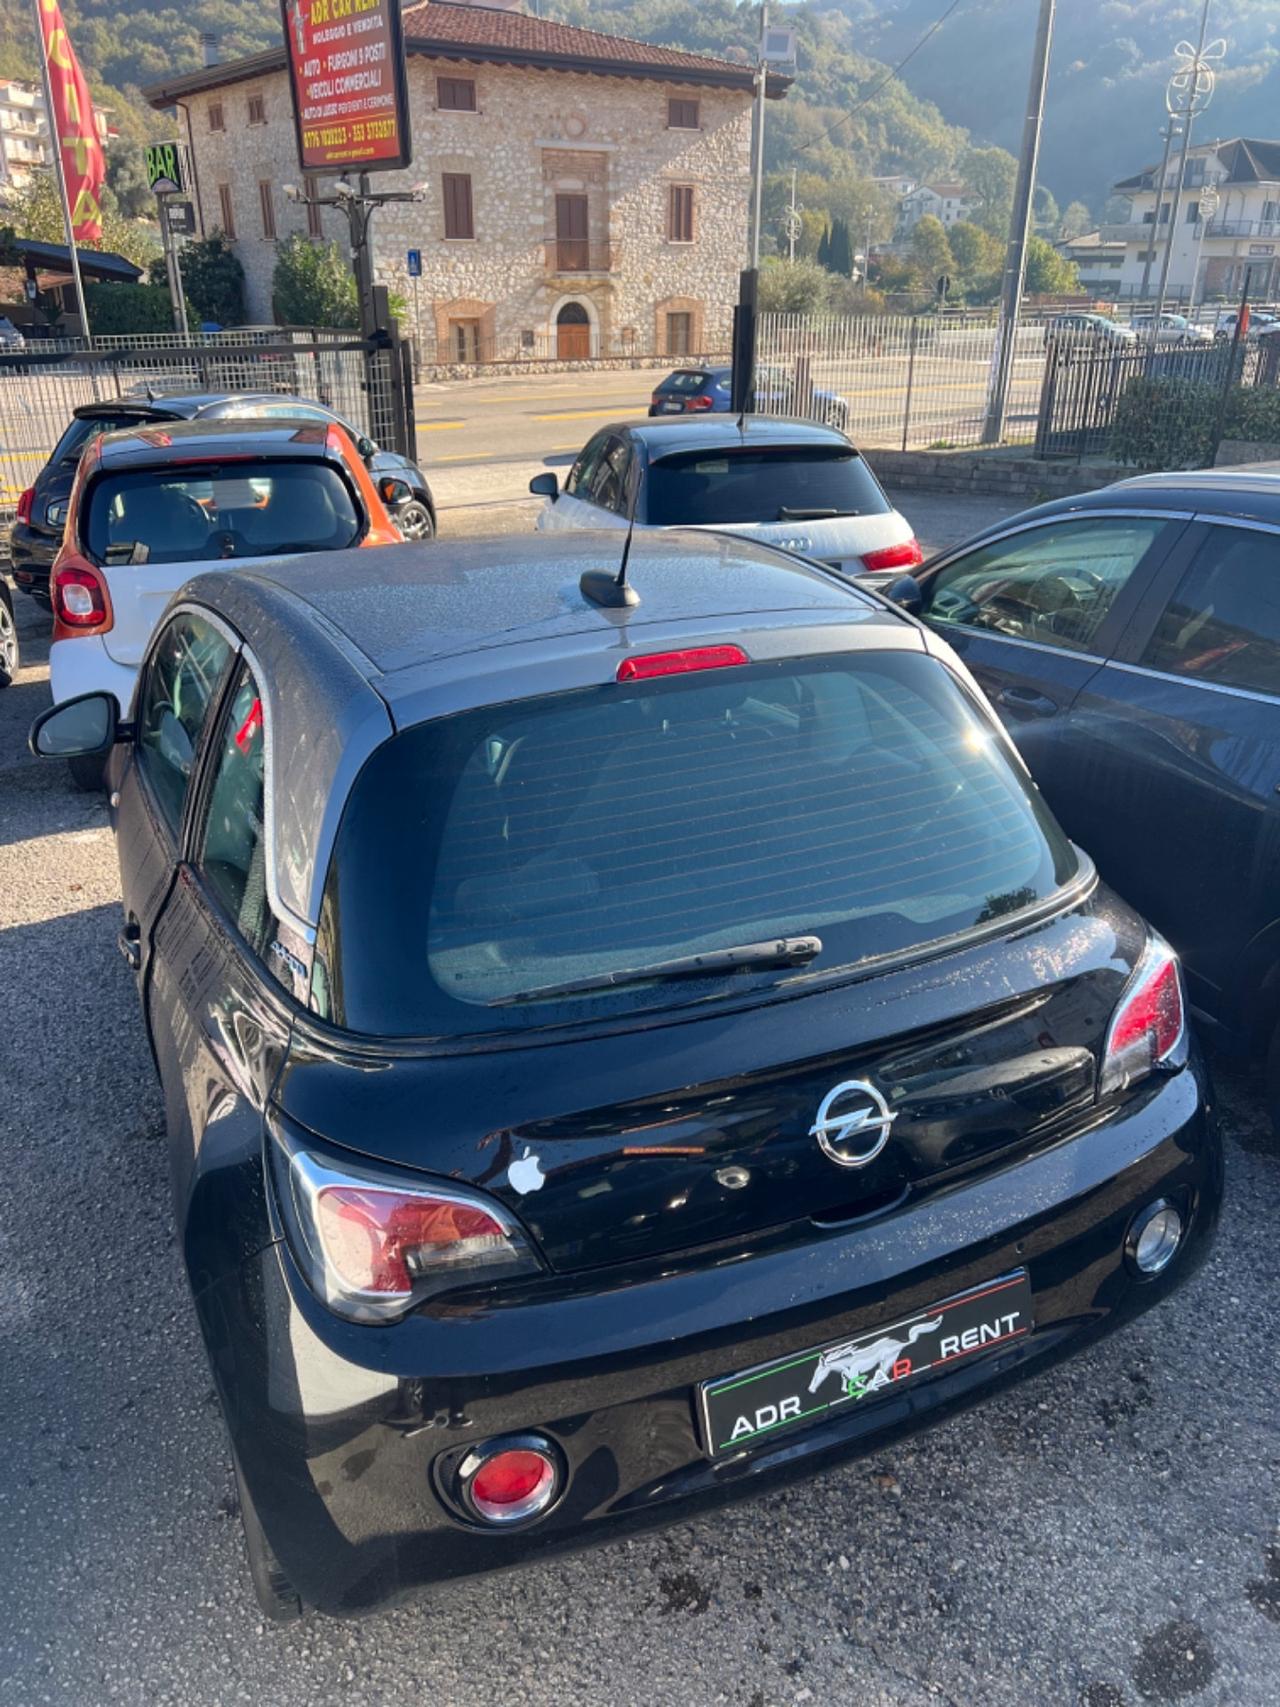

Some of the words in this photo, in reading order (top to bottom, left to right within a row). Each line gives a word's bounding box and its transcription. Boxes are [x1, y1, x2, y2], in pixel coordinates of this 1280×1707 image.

[311, 0, 330, 26] ADR
[313, 26, 345, 45] NOLEGGIO
[347, 23, 352, 36] E
[353, 15, 383, 33] VENDITA
[304, 59, 321, 77] AUTO
[328, 51, 358, 72] FURGONI
[365, 42, 385, 63] POSTI
[309, 79, 334, 100] VEICOLI
[335, 70, 381, 95] COMMERCIALI
[144, 144, 178, 189] BAR
[730, 1396, 801, 1440] ADR
[848, 1358, 911, 1399] CAR
[940, 1312, 1020, 1359] RENT
